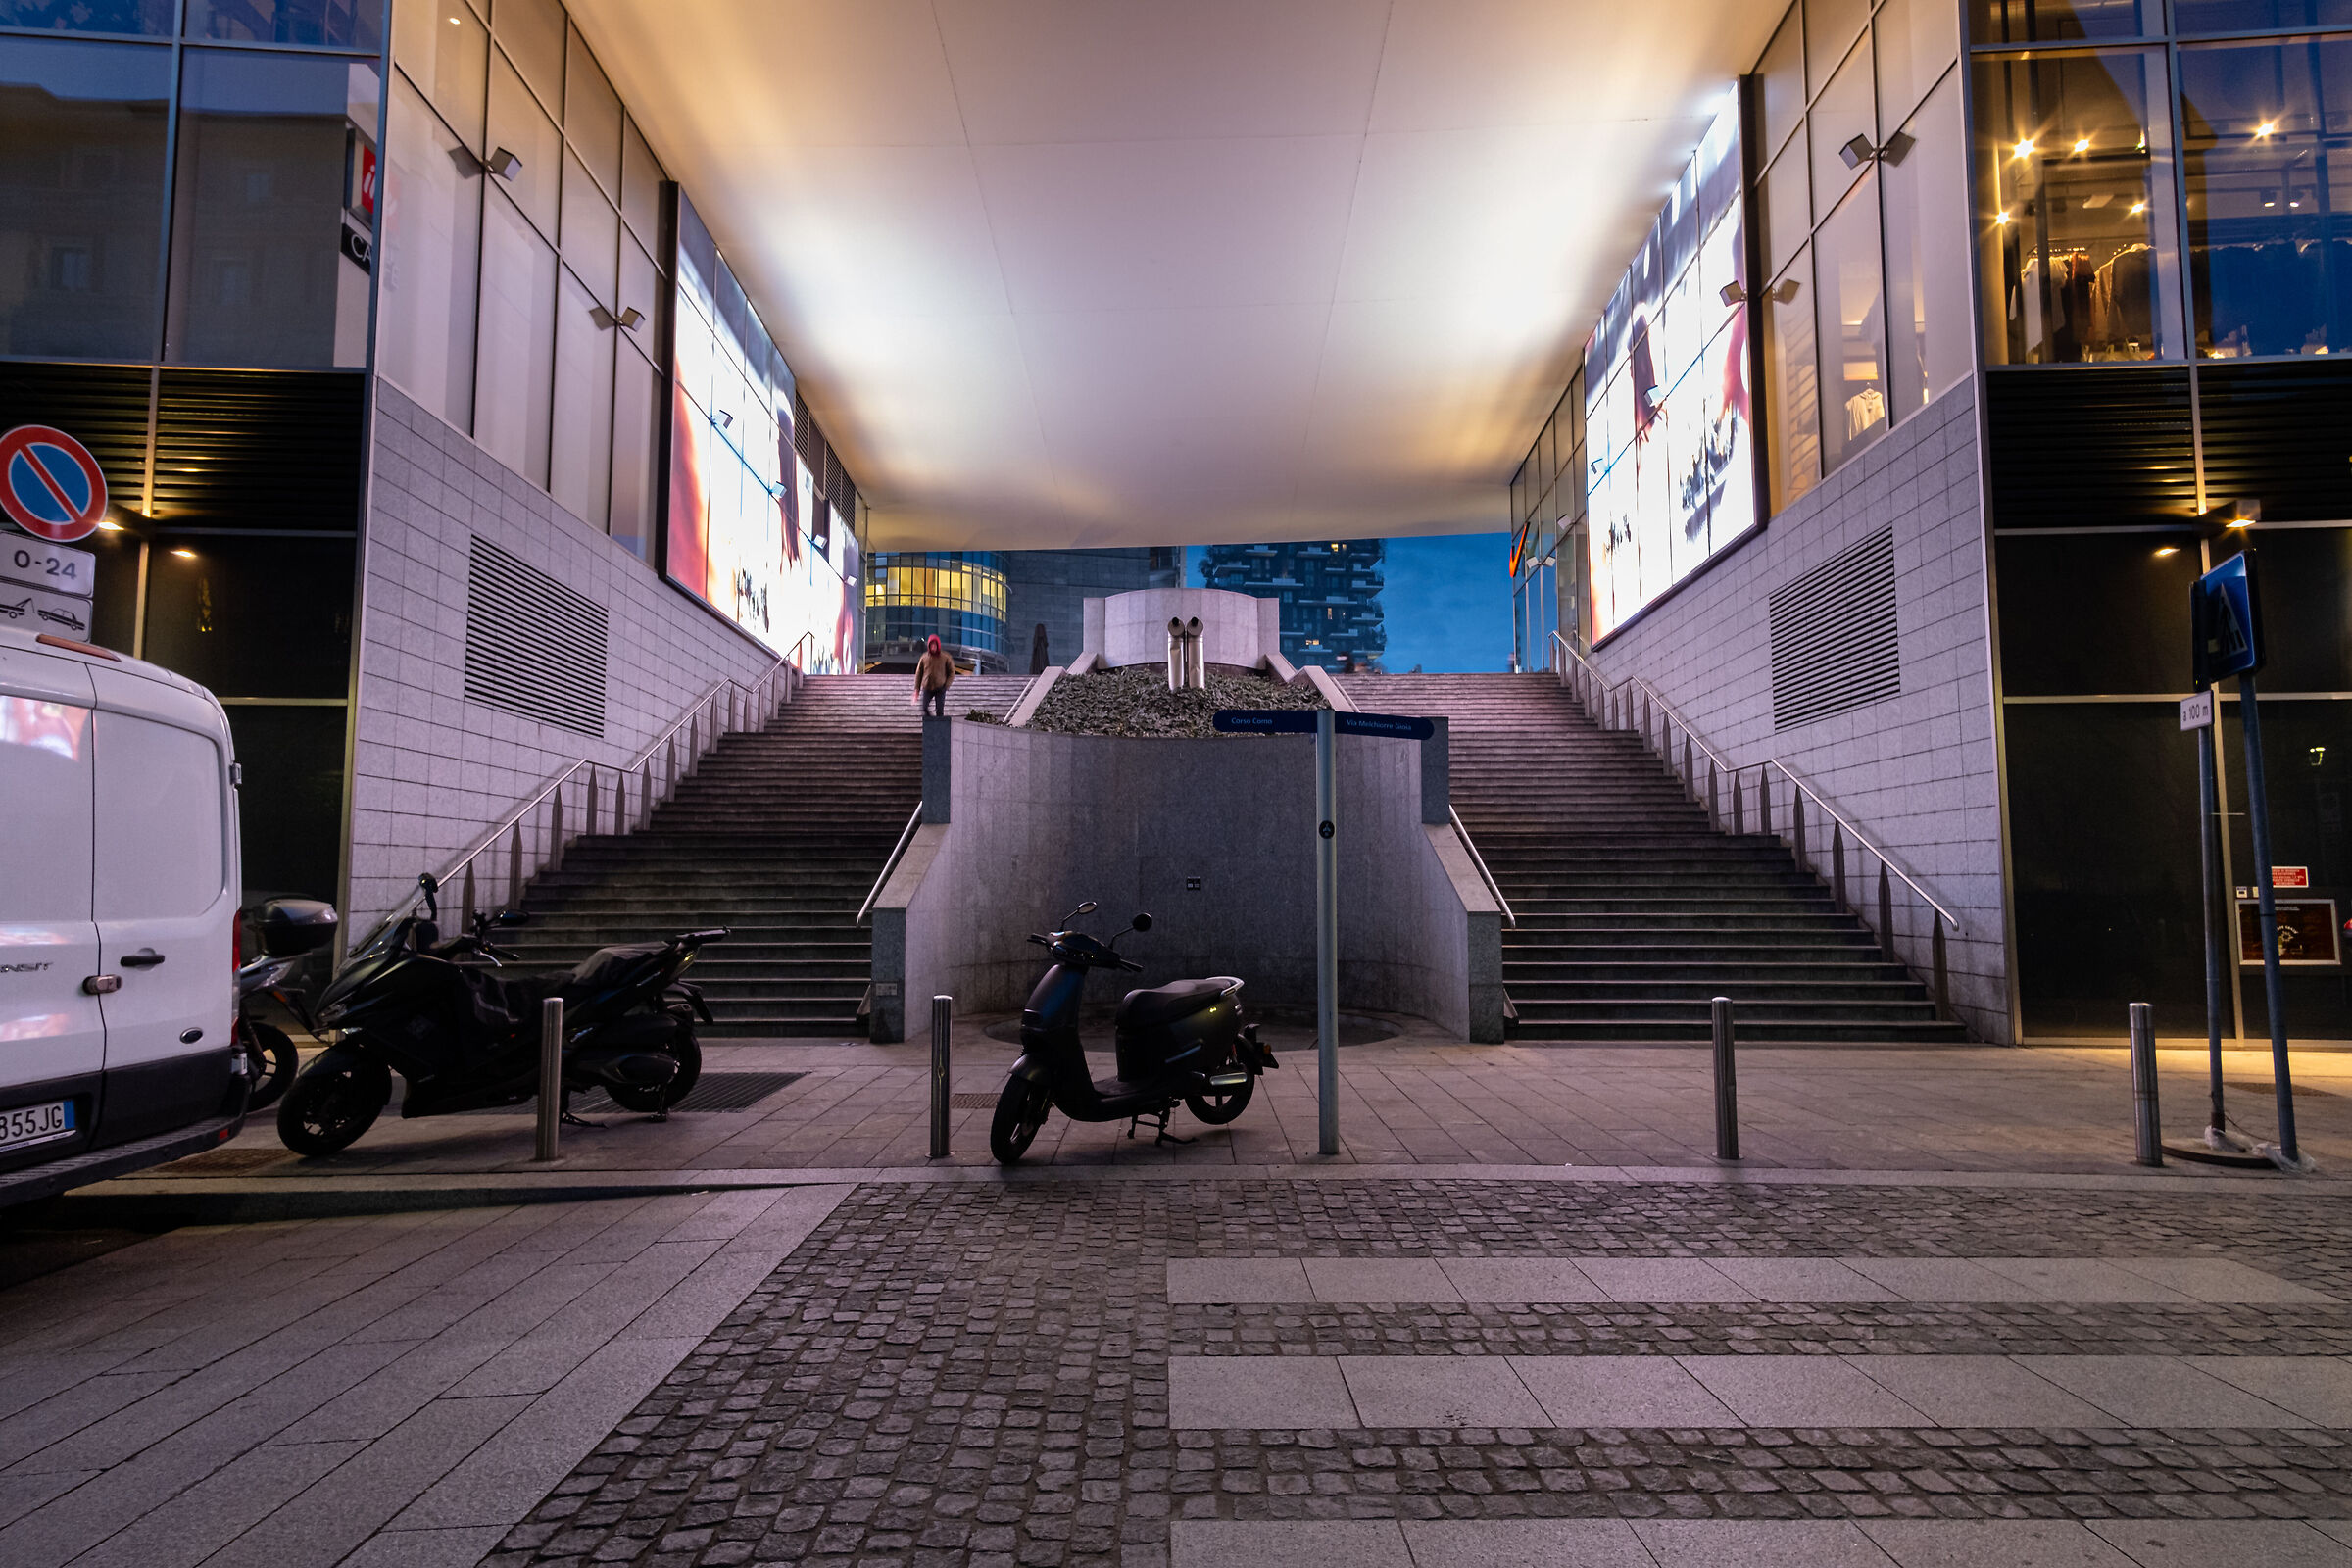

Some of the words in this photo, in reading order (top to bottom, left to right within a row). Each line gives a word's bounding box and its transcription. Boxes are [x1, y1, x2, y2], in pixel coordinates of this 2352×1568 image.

[2182, 710, 2187, 722] a
[2188, 704, 2200, 720] 100
[2202, 705, 2209, 716] m
[1358, 720, 1394, 730] Melchiorre
